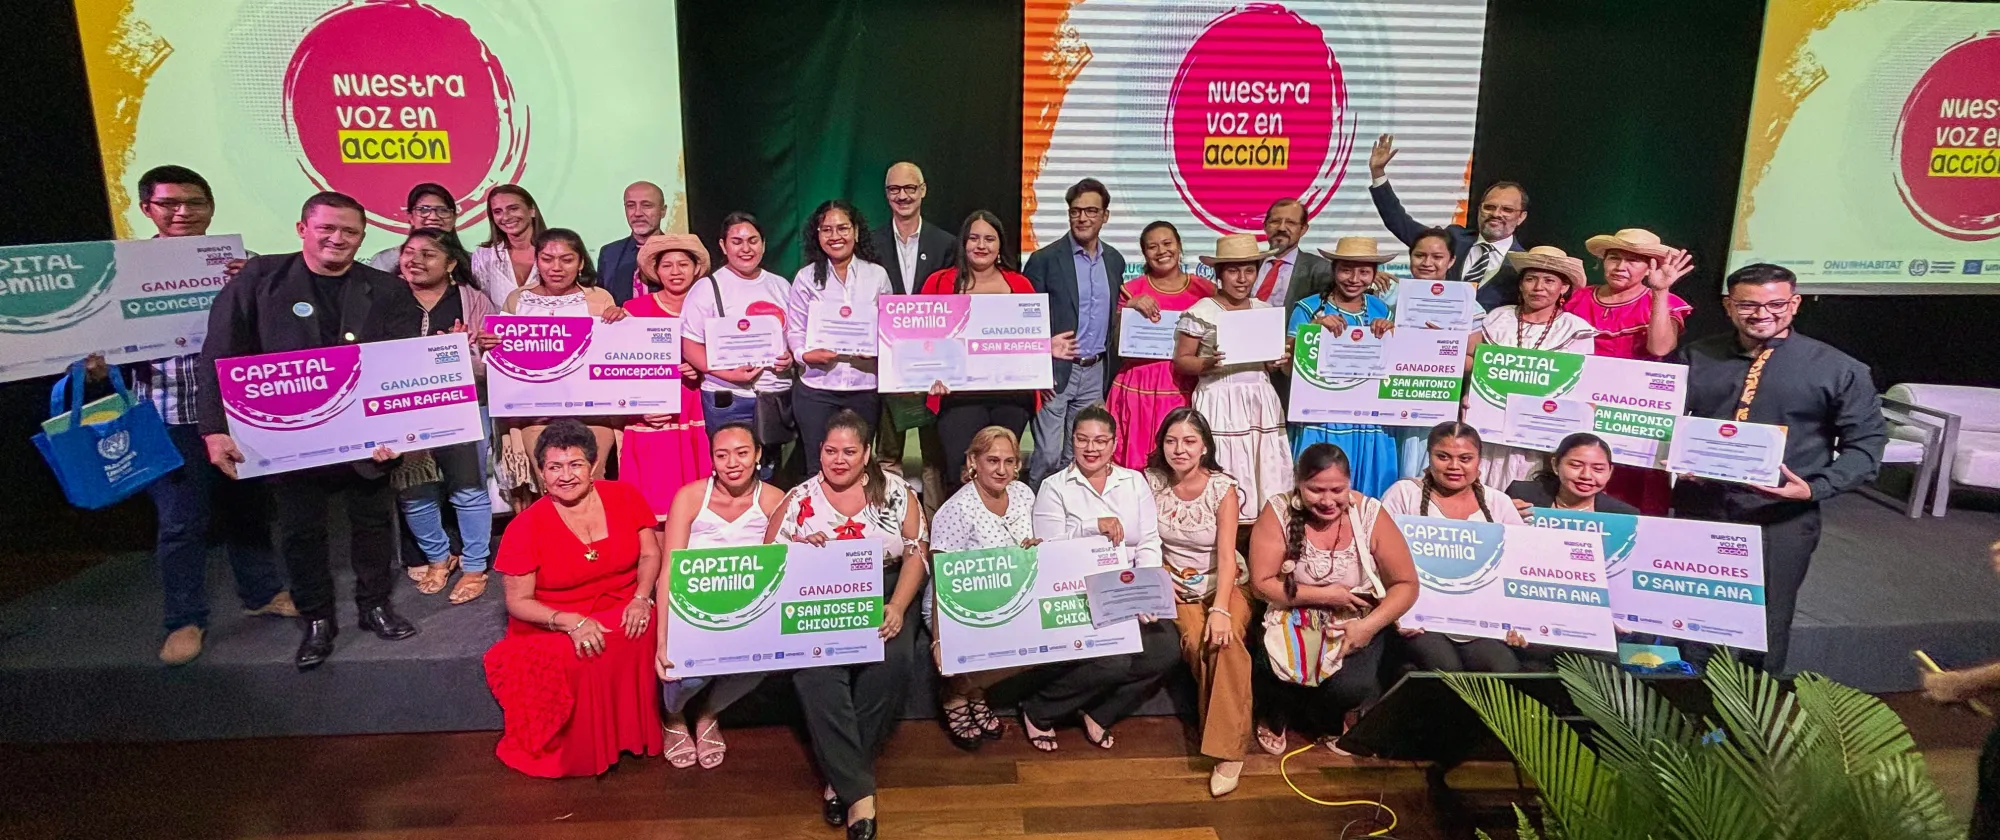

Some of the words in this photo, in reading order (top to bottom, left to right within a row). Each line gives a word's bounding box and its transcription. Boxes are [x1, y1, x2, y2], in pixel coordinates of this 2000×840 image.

[333, 73, 466, 98] Nuestra
[1207, 81, 1310, 104] Nuestra
[400, 106, 437, 129] en
[1940, 98, 2000, 119] Nues
[1254, 112, 1283, 135] en
[342, 132, 447, 160] acción
[1983, 127, 2000, 147] e
[1204, 138, 1286, 166] acción
[1930, 150, 2000, 174] acció
[886, 302, 953, 315] CAPITAL
[493, 324, 572, 338] CAPITAL
[892, 316, 947, 329] semilla
[981, 326, 1042, 336] GANADORES
[502, 339, 565, 353] semilla
[981, 342, 1002, 352] SAN
[1003, 341, 1045, 352] RAFAEL
[604, 352, 672, 361] GANADORES
[1482, 351, 1560, 372] CAPITAL
[230, 356, 336, 383] CAPITAL
[603, 365, 673, 379] concepción
[1395, 363, 1456, 373] GANADORES
[1487, 366, 1550, 386] semilla
[244, 373, 329, 400] semilla
[380, 372, 463, 392] GANADORES
[1392, 378, 1411, 388] SAN
[1413, 379, 1456, 389] ANTONIO
[383, 396, 411, 411] SAN
[415, 389, 469, 407] RAFAEL
[1391, 390, 1403, 398] DE
[1405, 390, 1451, 399] LOMERIO
[1591, 392, 1672, 410] GANADORES
[1595, 408, 1612, 419] AN
[1613, 411, 1673, 427] ANTONIO
[1605, 421, 1666, 439] LOMERIO
[1404, 523, 1483, 545] CAPITAL
[1412, 541, 1476, 561] semilla
[679, 555, 763, 575] CAPITAL
[942, 554, 1018, 576] CAPITAL
[1520, 566, 1597, 582] GANADORES
[1652, 559, 1749, 578] GANADORES
[687, 573, 755, 593] semilla
[799, 582, 873, 596] GANADORES
[952, 572, 1012, 593] semilla
[1652, 580, 1708, 596] SANTA
[1714, 585, 1752, 600] ANA
[1520, 586, 1567, 601] SANTA
[1571, 591, 1601, 604] ANA
[797, 604, 822, 616] SAN
[824, 602, 855, 615] JOSE
[858, 601, 874, 612] DE
[1054, 601, 1076, 612] SAN
[797, 615, 870, 631] CHIQUITOS
